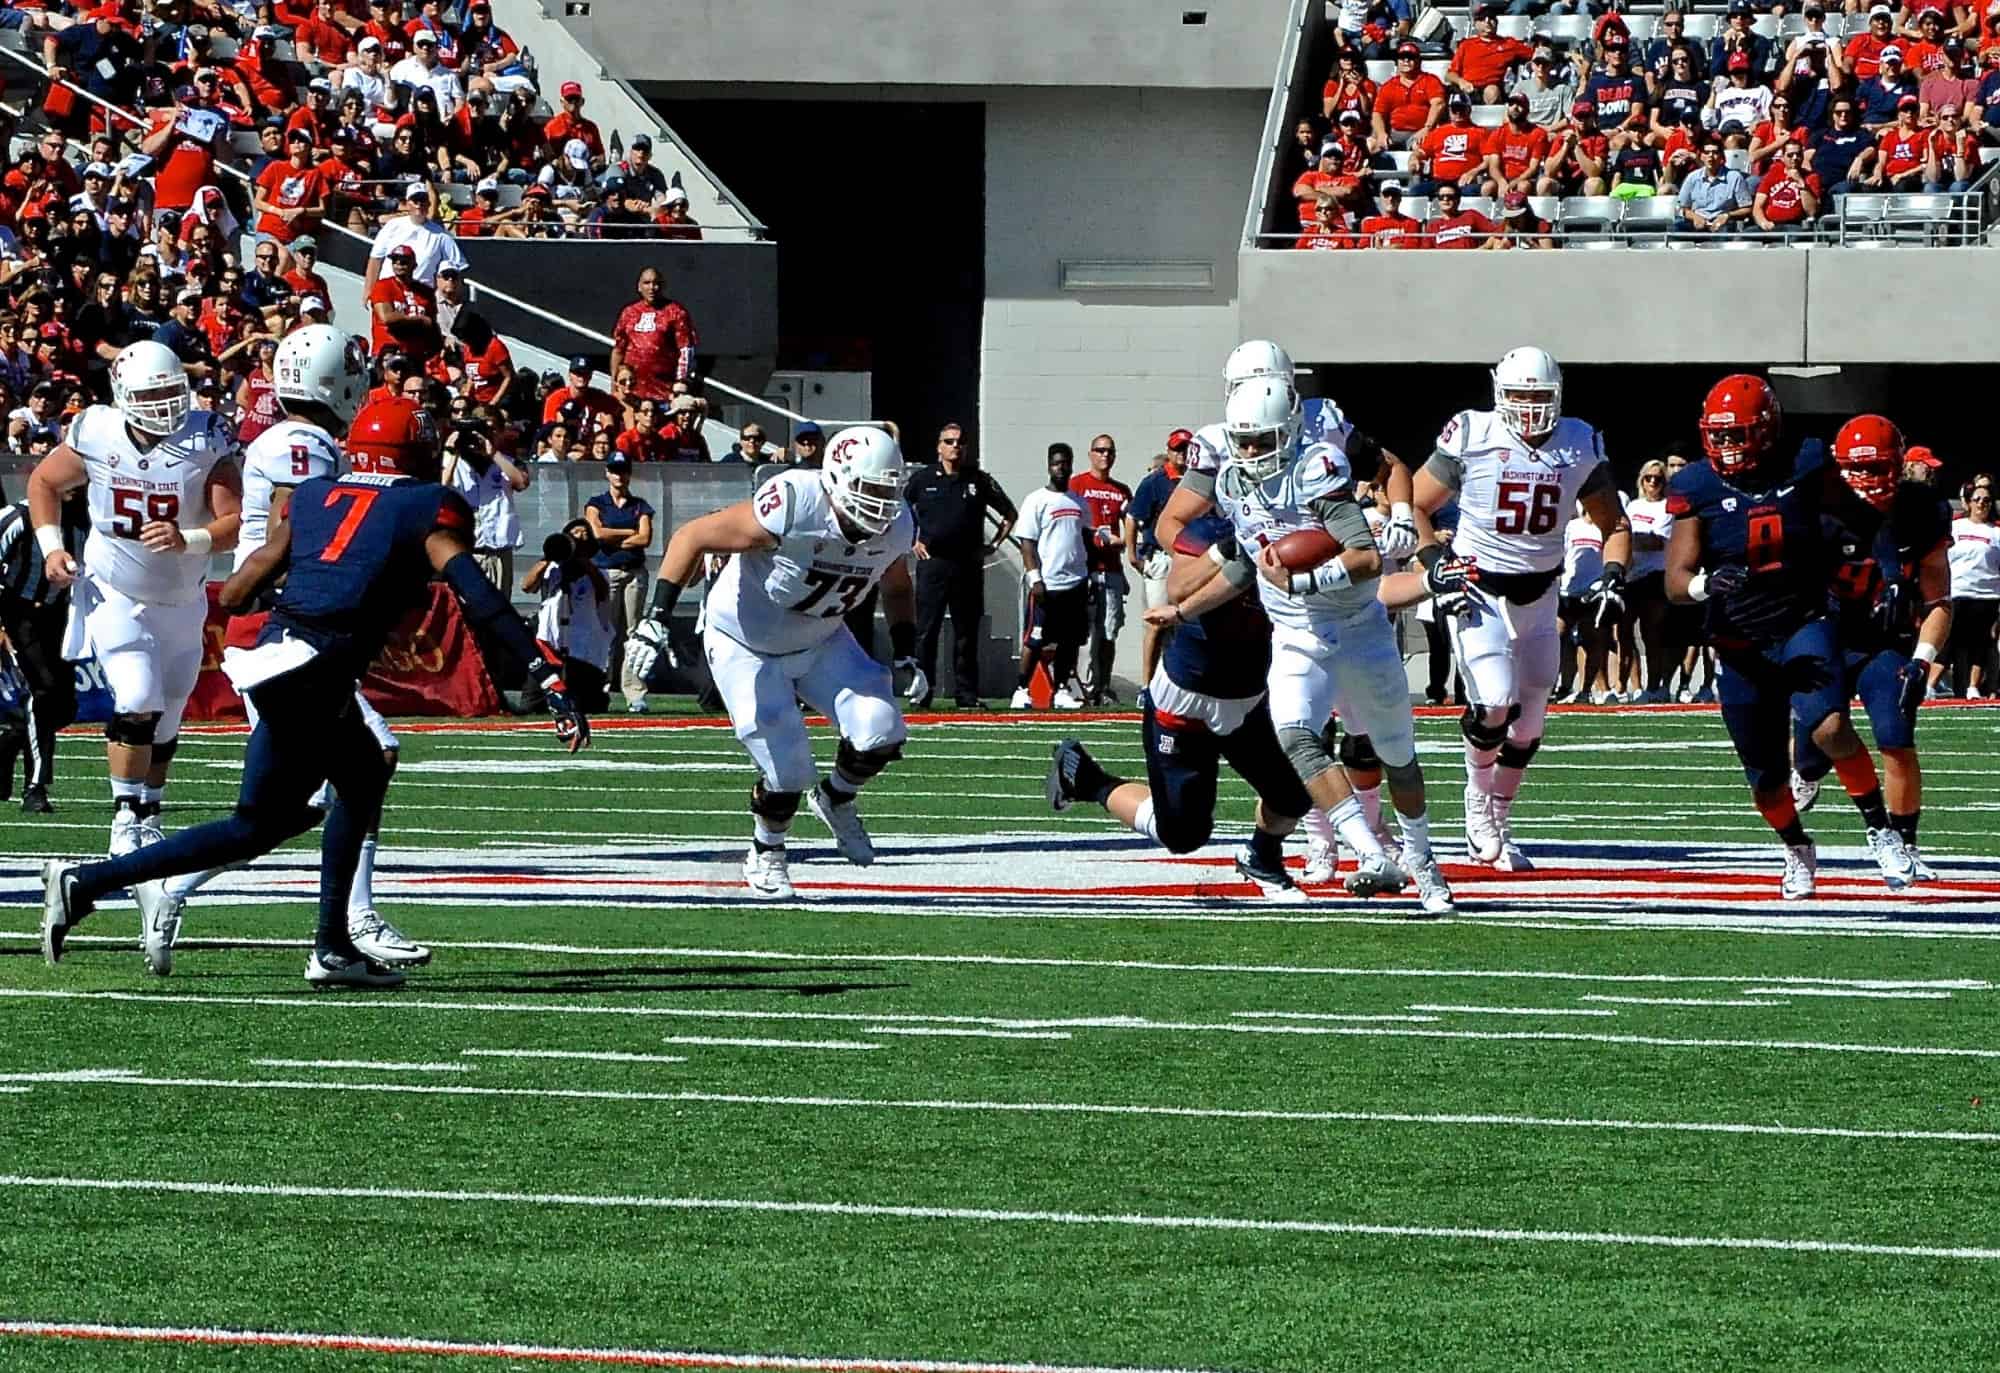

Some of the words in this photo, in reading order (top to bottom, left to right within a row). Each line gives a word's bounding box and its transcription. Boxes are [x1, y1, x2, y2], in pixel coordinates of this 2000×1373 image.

[290, 445, 310, 476] 9
[1502, 471, 1544, 481] WASHINGTON
[112, 476, 156, 490] WASHINGTON
[158, 482, 179, 491] STATE
[1083, 489, 1124, 502] ARIZONA
[758, 483, 783, 518] 73
[1496, 482, 1562, 535] 56
[319, 486, 380, 563] 7
[791, 568, 871, 618] 73
